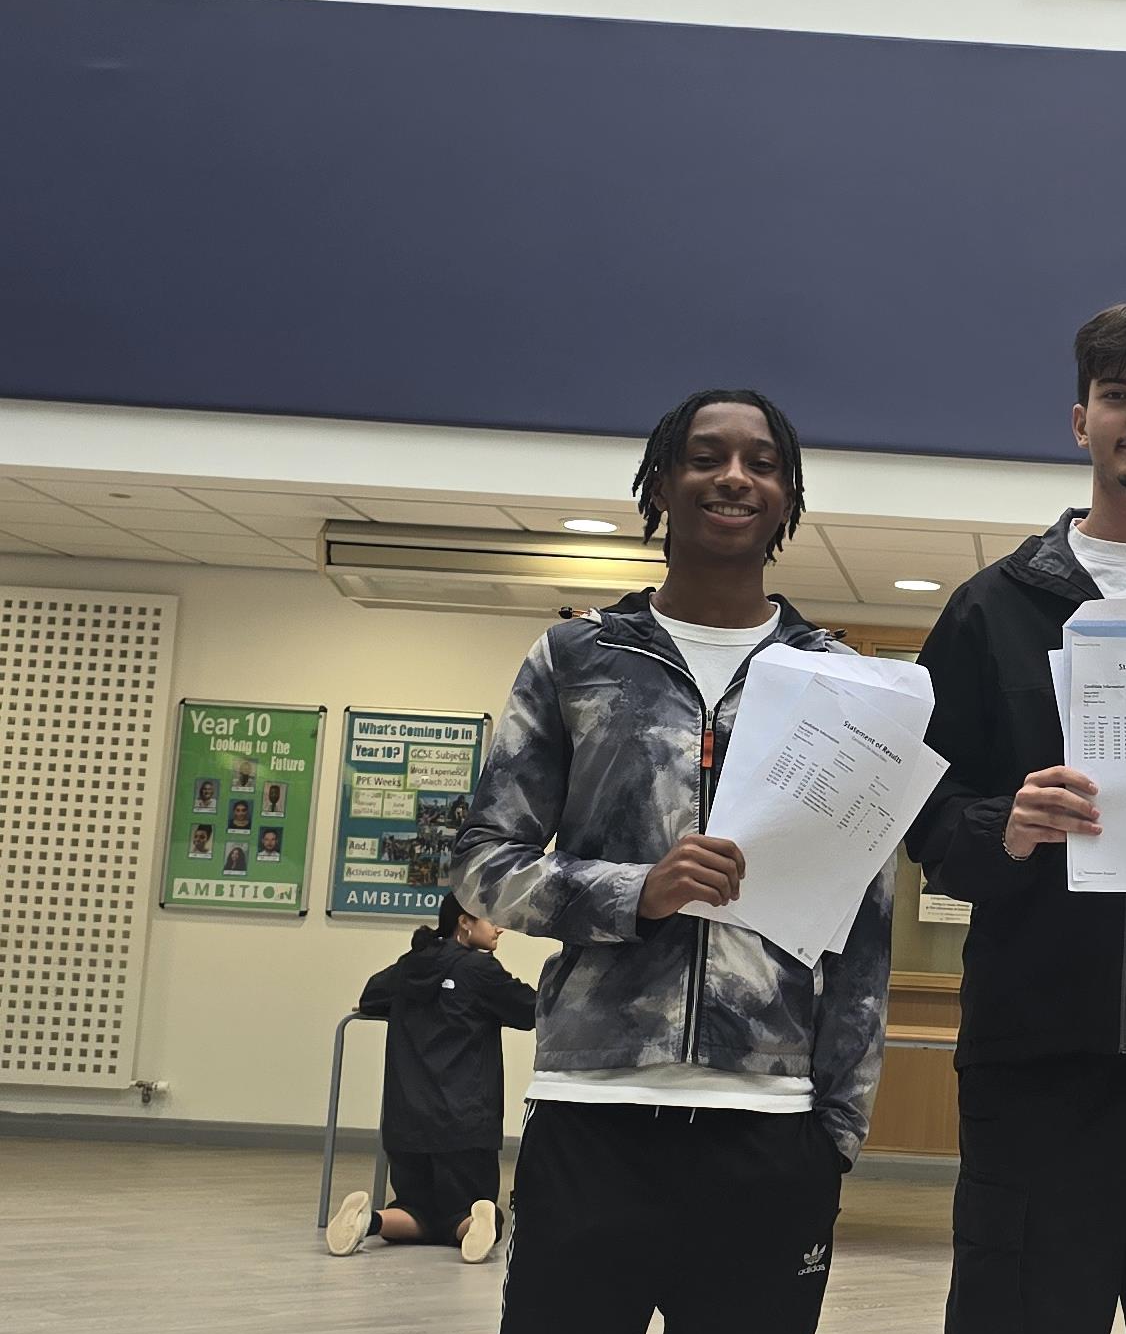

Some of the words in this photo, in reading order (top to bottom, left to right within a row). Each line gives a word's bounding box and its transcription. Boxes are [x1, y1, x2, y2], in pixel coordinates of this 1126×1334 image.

[190, 710, 240, 735] Year
[245, 712, 271, 737] 10
[400, 724, 442, 740] Coming
[444, 727, 459, 741] Up
[843, 720, 876, 745] Statement
[210, 736, 253, 755] Looking
[256, 740, 267, 753] to
[272, 740, 291, 755] the
[355, 745, 379, 757] Year
[382, 746, 401, 759] 10?
[410, 748, 433, 759] GCSE
[436, 750, 470, 761] Subjects
[270, 756, 305, 772] Future
[410, 765, 428, 775] Work
[374, 777, 401, 787] Weeks
[177, 881, 293, 900] AMBITION
